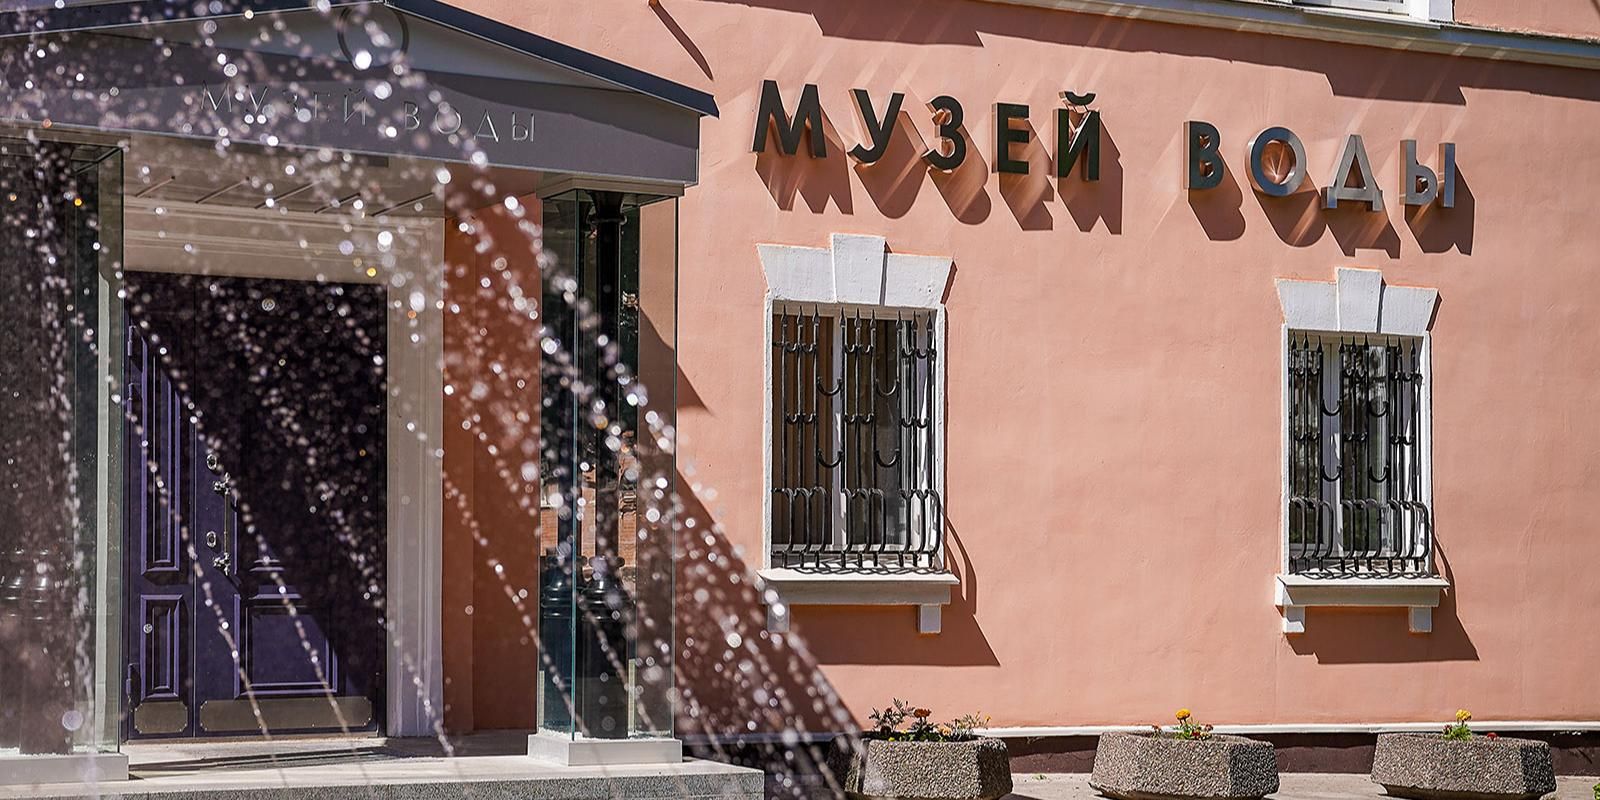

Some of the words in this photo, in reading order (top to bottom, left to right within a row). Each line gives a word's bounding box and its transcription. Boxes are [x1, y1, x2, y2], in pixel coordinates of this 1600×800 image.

[403, 102, 536, 142] ВОДЫ
[752, 79, 1101, 181] МУЗЕЙ
[1184, 120, 1456, 212] ВОДЫ
